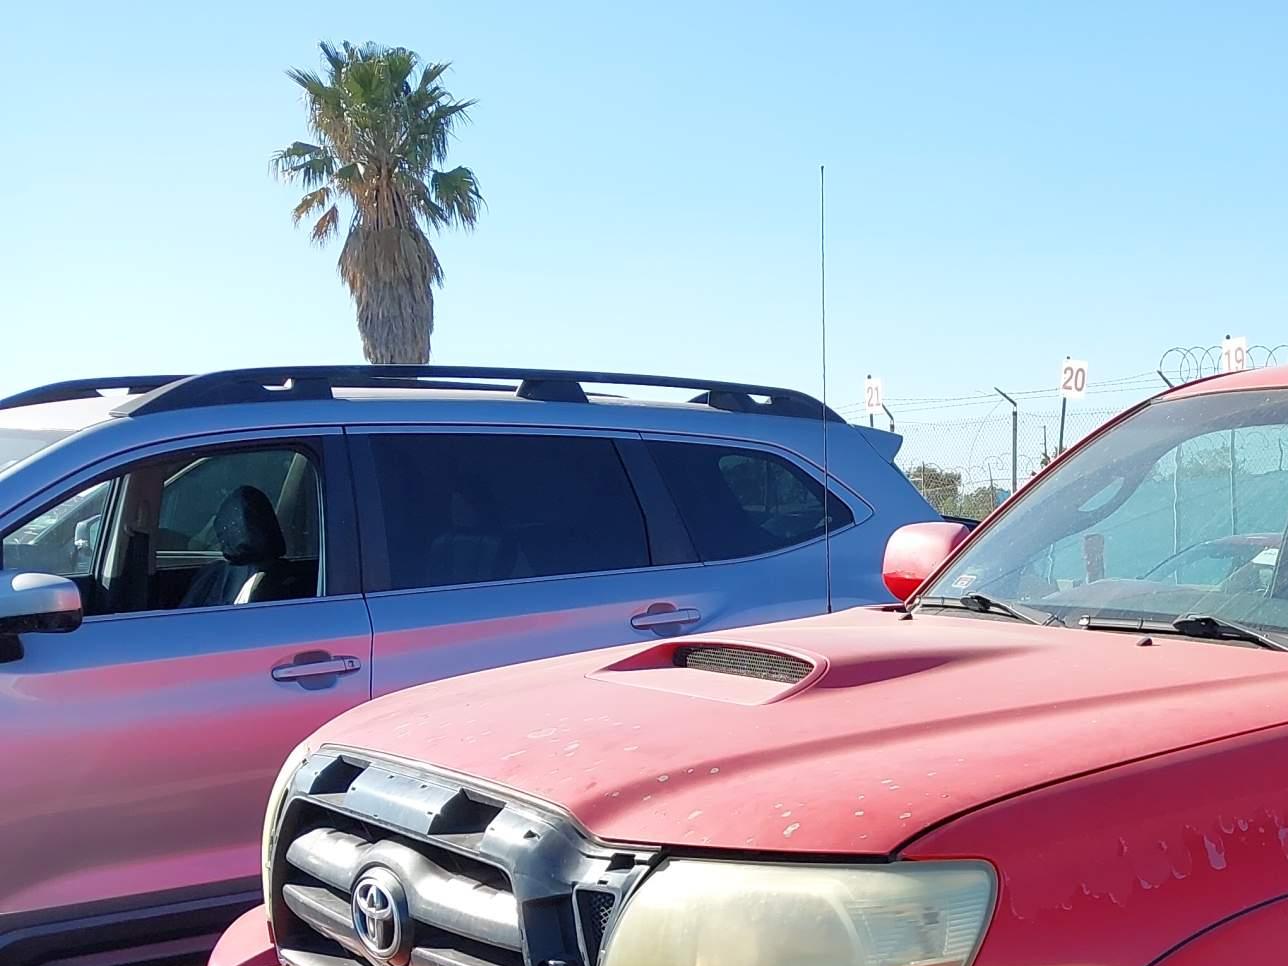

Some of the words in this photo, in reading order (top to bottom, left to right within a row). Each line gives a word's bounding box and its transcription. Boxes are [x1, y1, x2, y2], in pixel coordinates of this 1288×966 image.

[1225, 347, 1245, 371] 19
[1062, 366, 1086, 392] 20
[866, 385, 881, 408] 21
